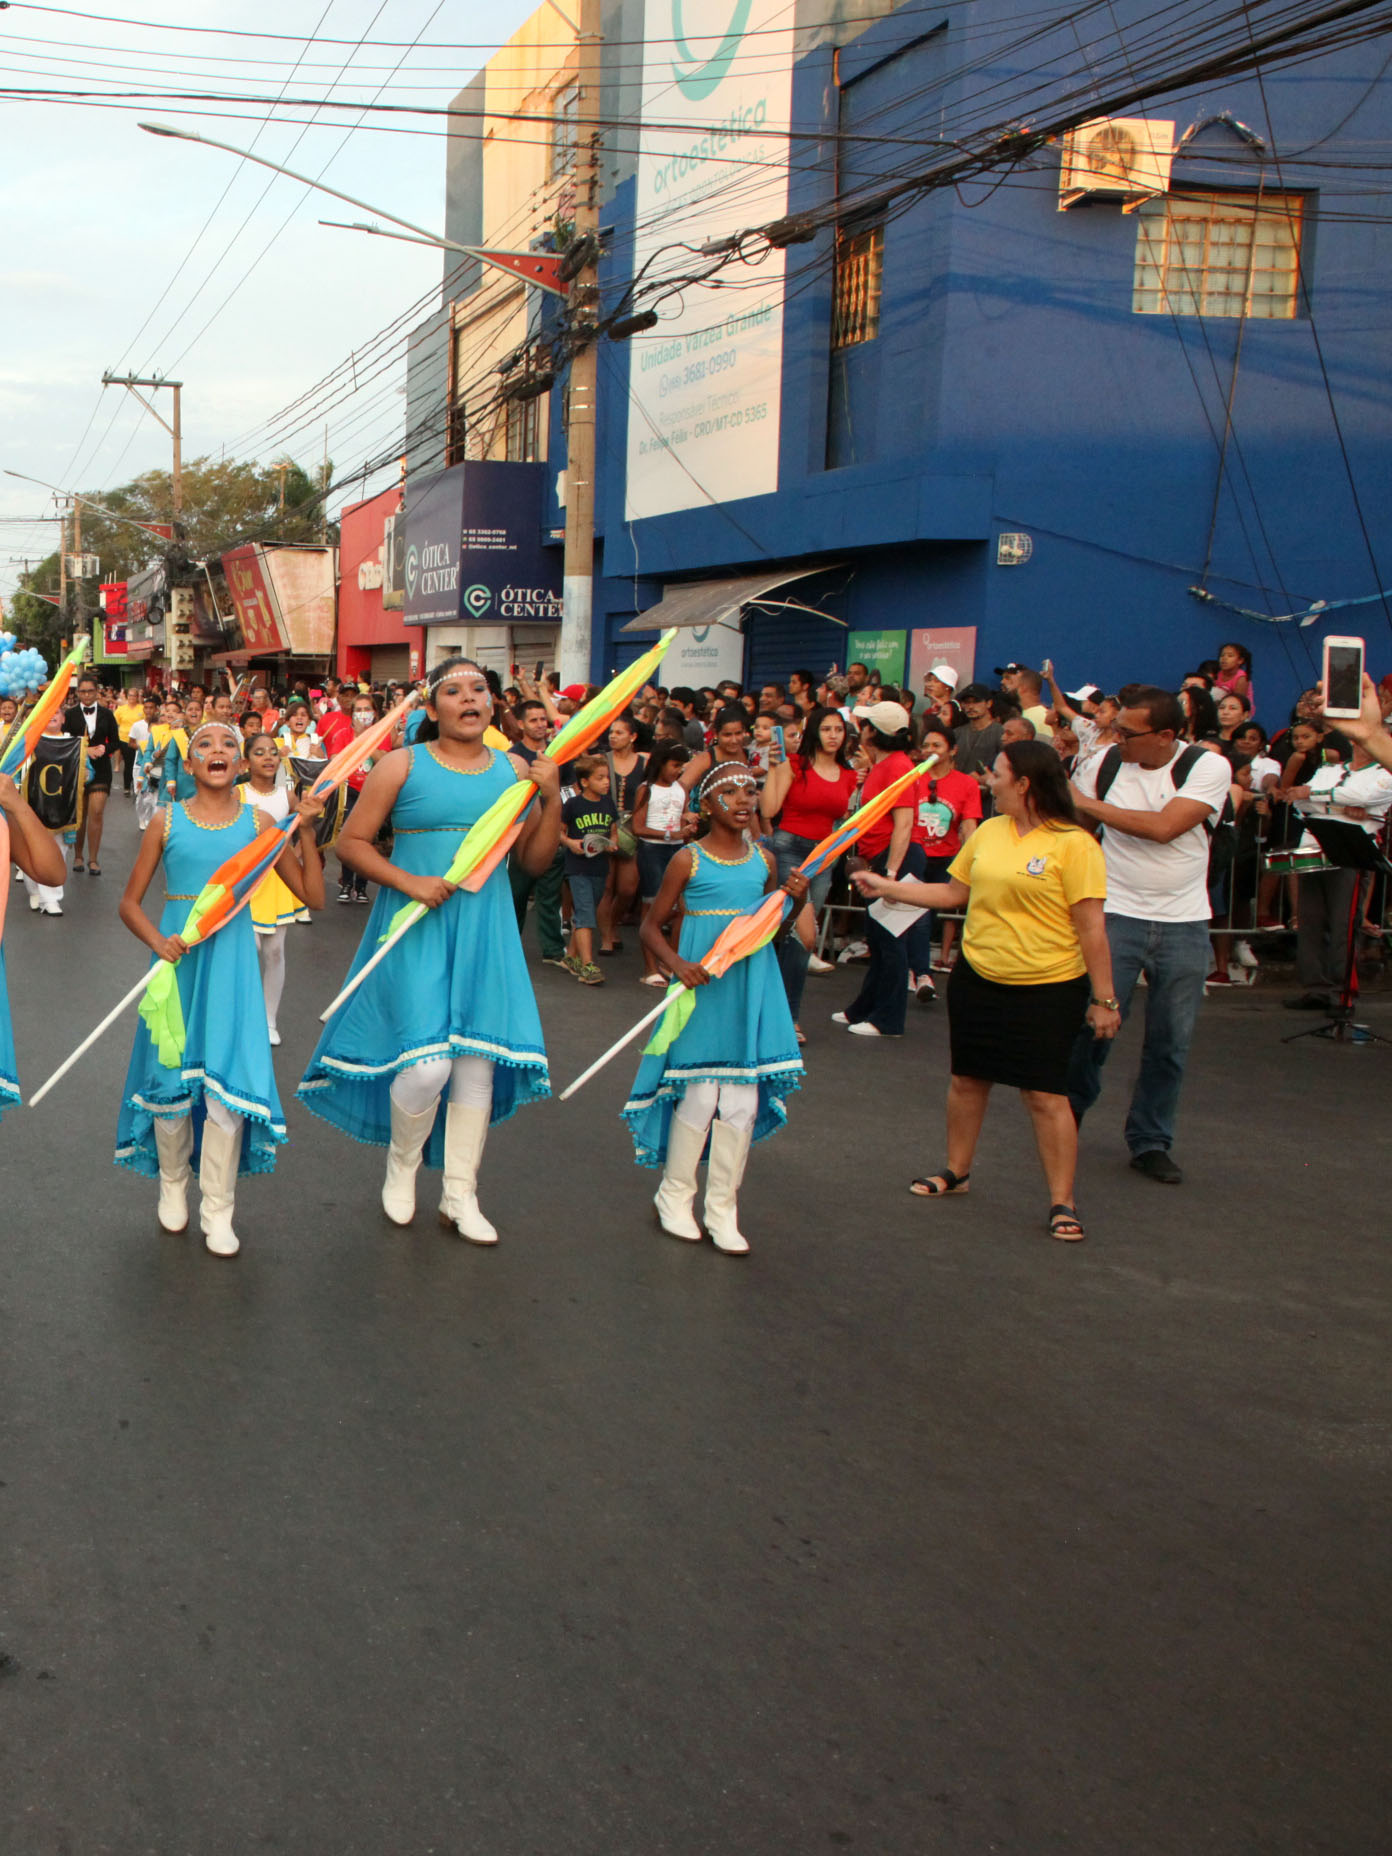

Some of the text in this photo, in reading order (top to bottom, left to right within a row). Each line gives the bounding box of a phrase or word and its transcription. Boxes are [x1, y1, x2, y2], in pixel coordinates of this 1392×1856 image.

[654, 97, 767, 194] ortoestética
[640, 338, 683, 372] Unidade
[727, 301, 771, 337] Grande
[422, 542, 450, 570] ÓTICA
[421, 567, 457, 596] CENTER
[501, 585, 555, 602] ÓTICA
[39, 763, 63, 797] C
